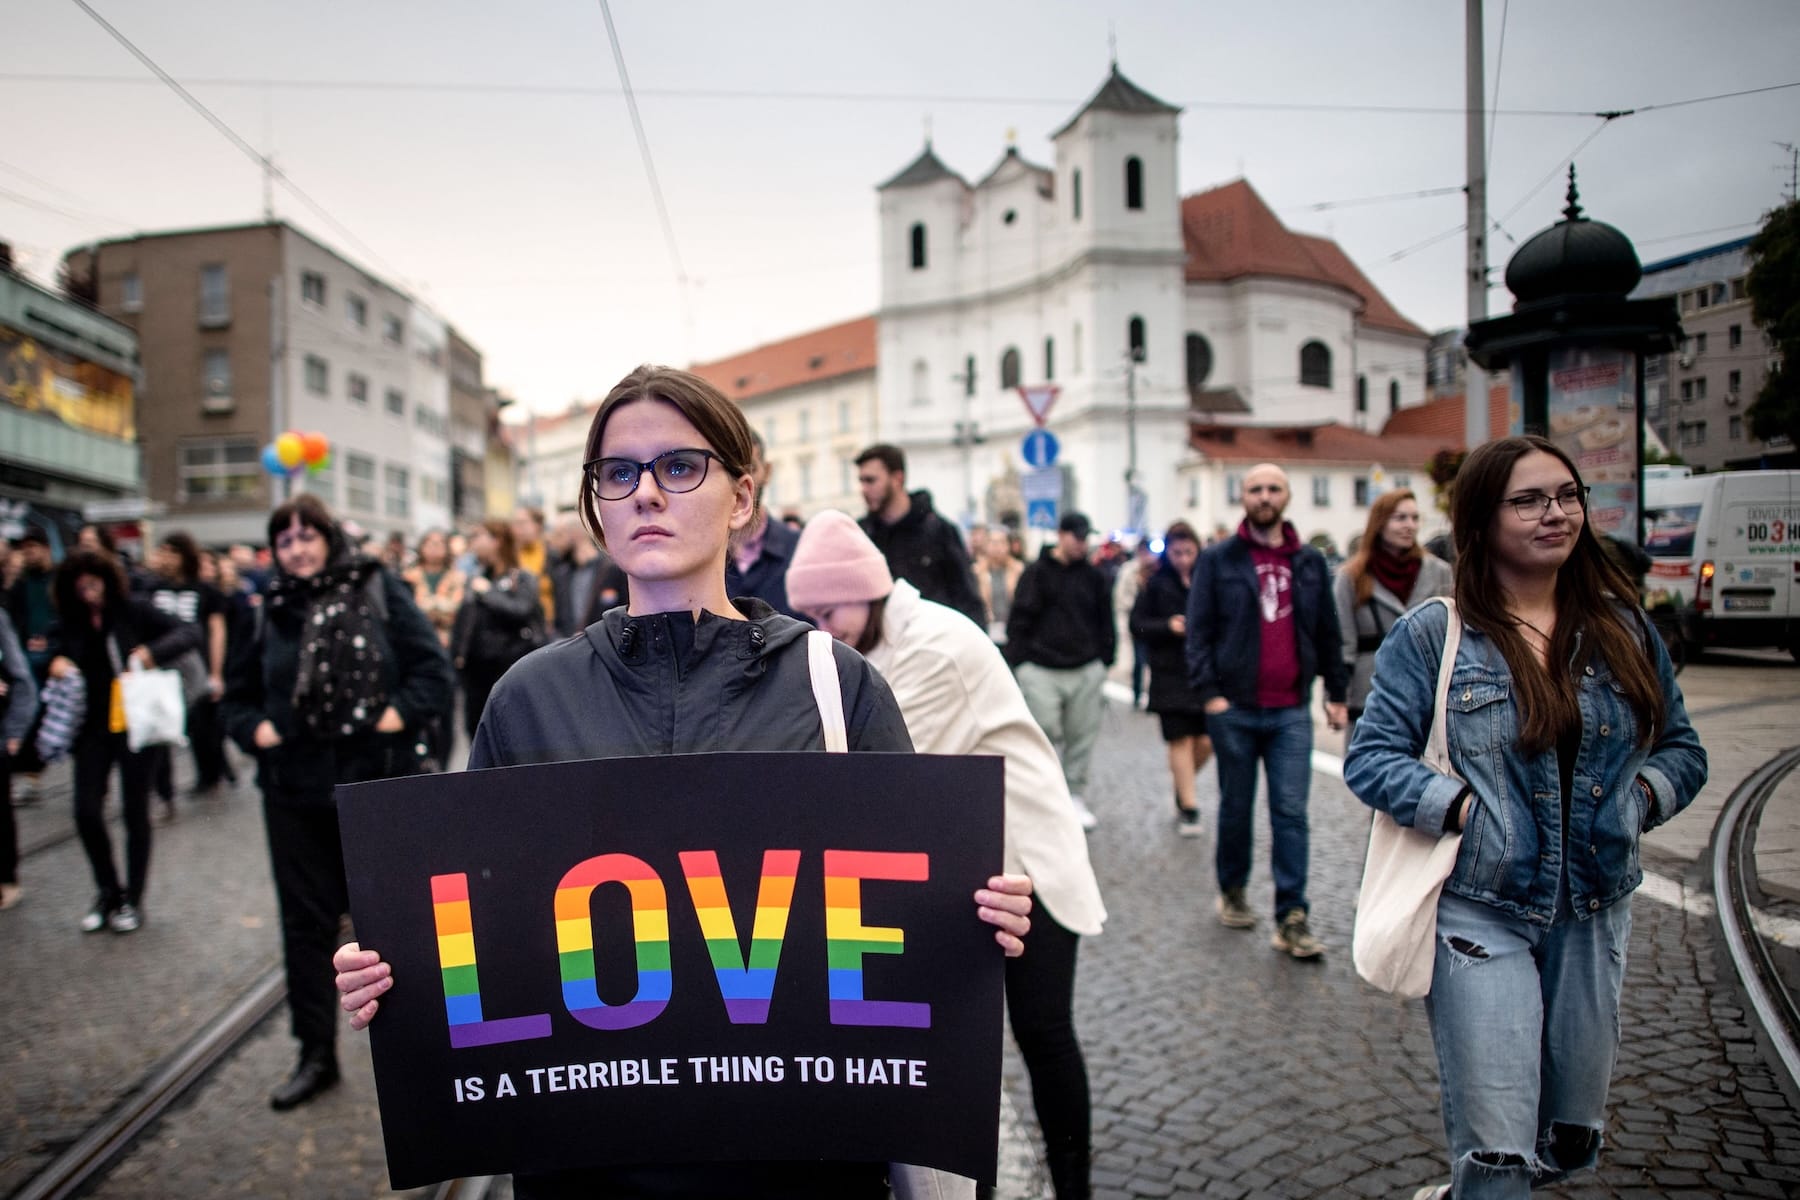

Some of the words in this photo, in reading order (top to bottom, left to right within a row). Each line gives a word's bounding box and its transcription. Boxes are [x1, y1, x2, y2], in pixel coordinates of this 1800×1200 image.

[1748, 523, 1768, 541] DO
[1770, 519, 1785, 543] 3
[429, 848, 931, 1049] LOVE
[454, 1076, 485, 1103] IS
[495, 1073, 518, 1098] A
[525, 1058, 680, 1094] TERRIBLE
[687, 1055, 785, 1083] THING
[794, 1056, 835, 1083] TO
[845, 1057, 927, 1087] HATE
